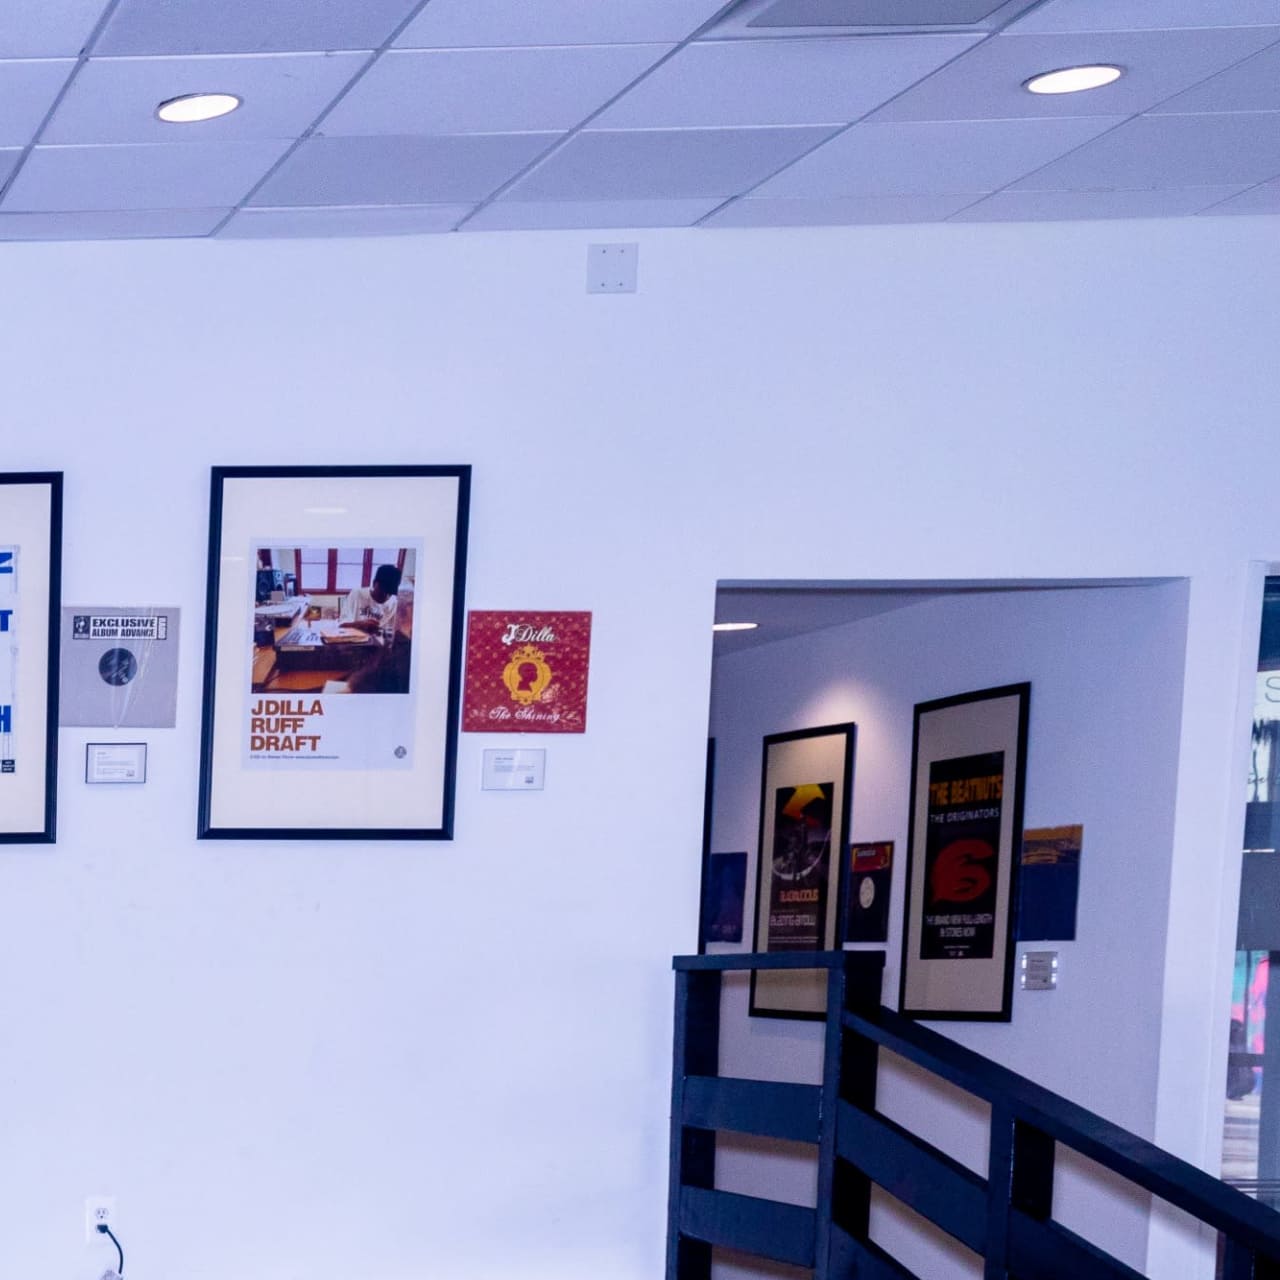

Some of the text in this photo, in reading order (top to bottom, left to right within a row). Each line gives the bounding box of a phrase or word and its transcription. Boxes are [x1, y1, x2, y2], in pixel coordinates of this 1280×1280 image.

[92, 618, 155, 628] EXCLUSIVE
[91, 628, 118, 637] ALBUM
[120, 628, 155, 637] ADVANCE
[251, 717, 305, 734] RUFF
[250, 735, 321, 752] DRAFT
